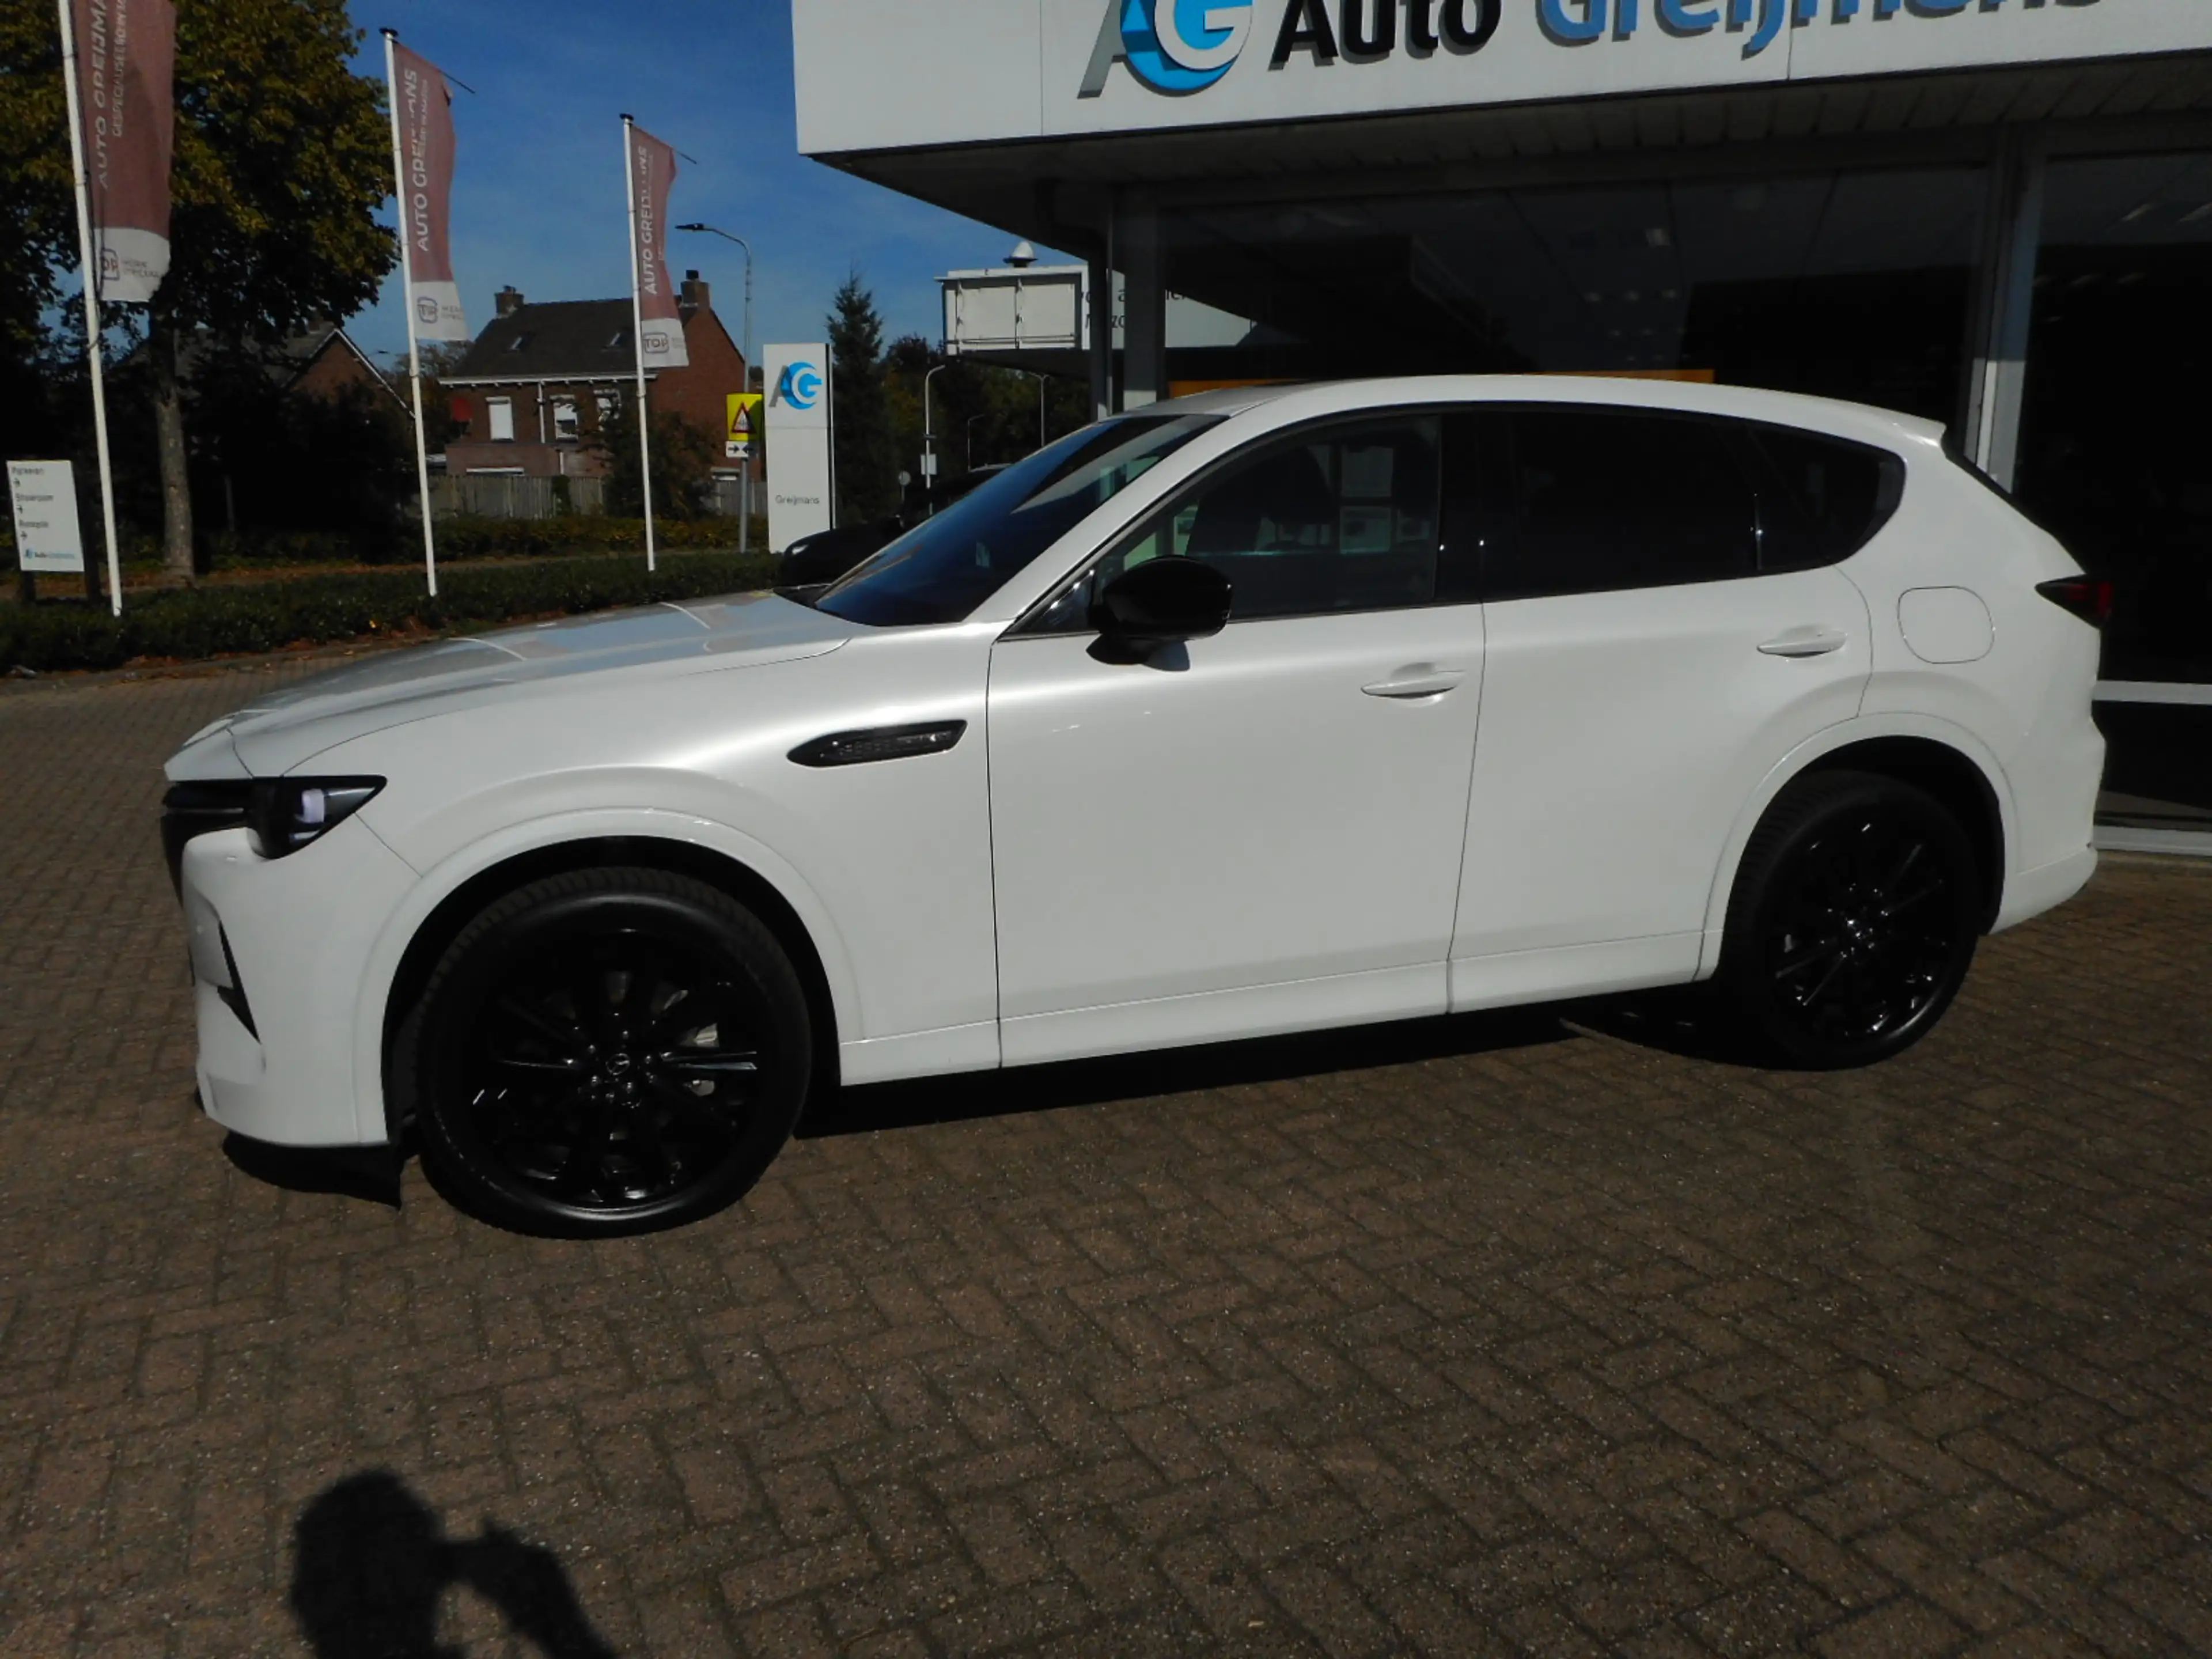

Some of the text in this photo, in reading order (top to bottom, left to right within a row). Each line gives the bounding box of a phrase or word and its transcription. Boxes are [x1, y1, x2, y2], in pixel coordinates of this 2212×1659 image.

[1268, 0, 1501, 69] Auto
[94, 115, 108, 190] AUTO
[413, 193, 429, 251] AUTO
[642, 248, 657, 296] AUTO
